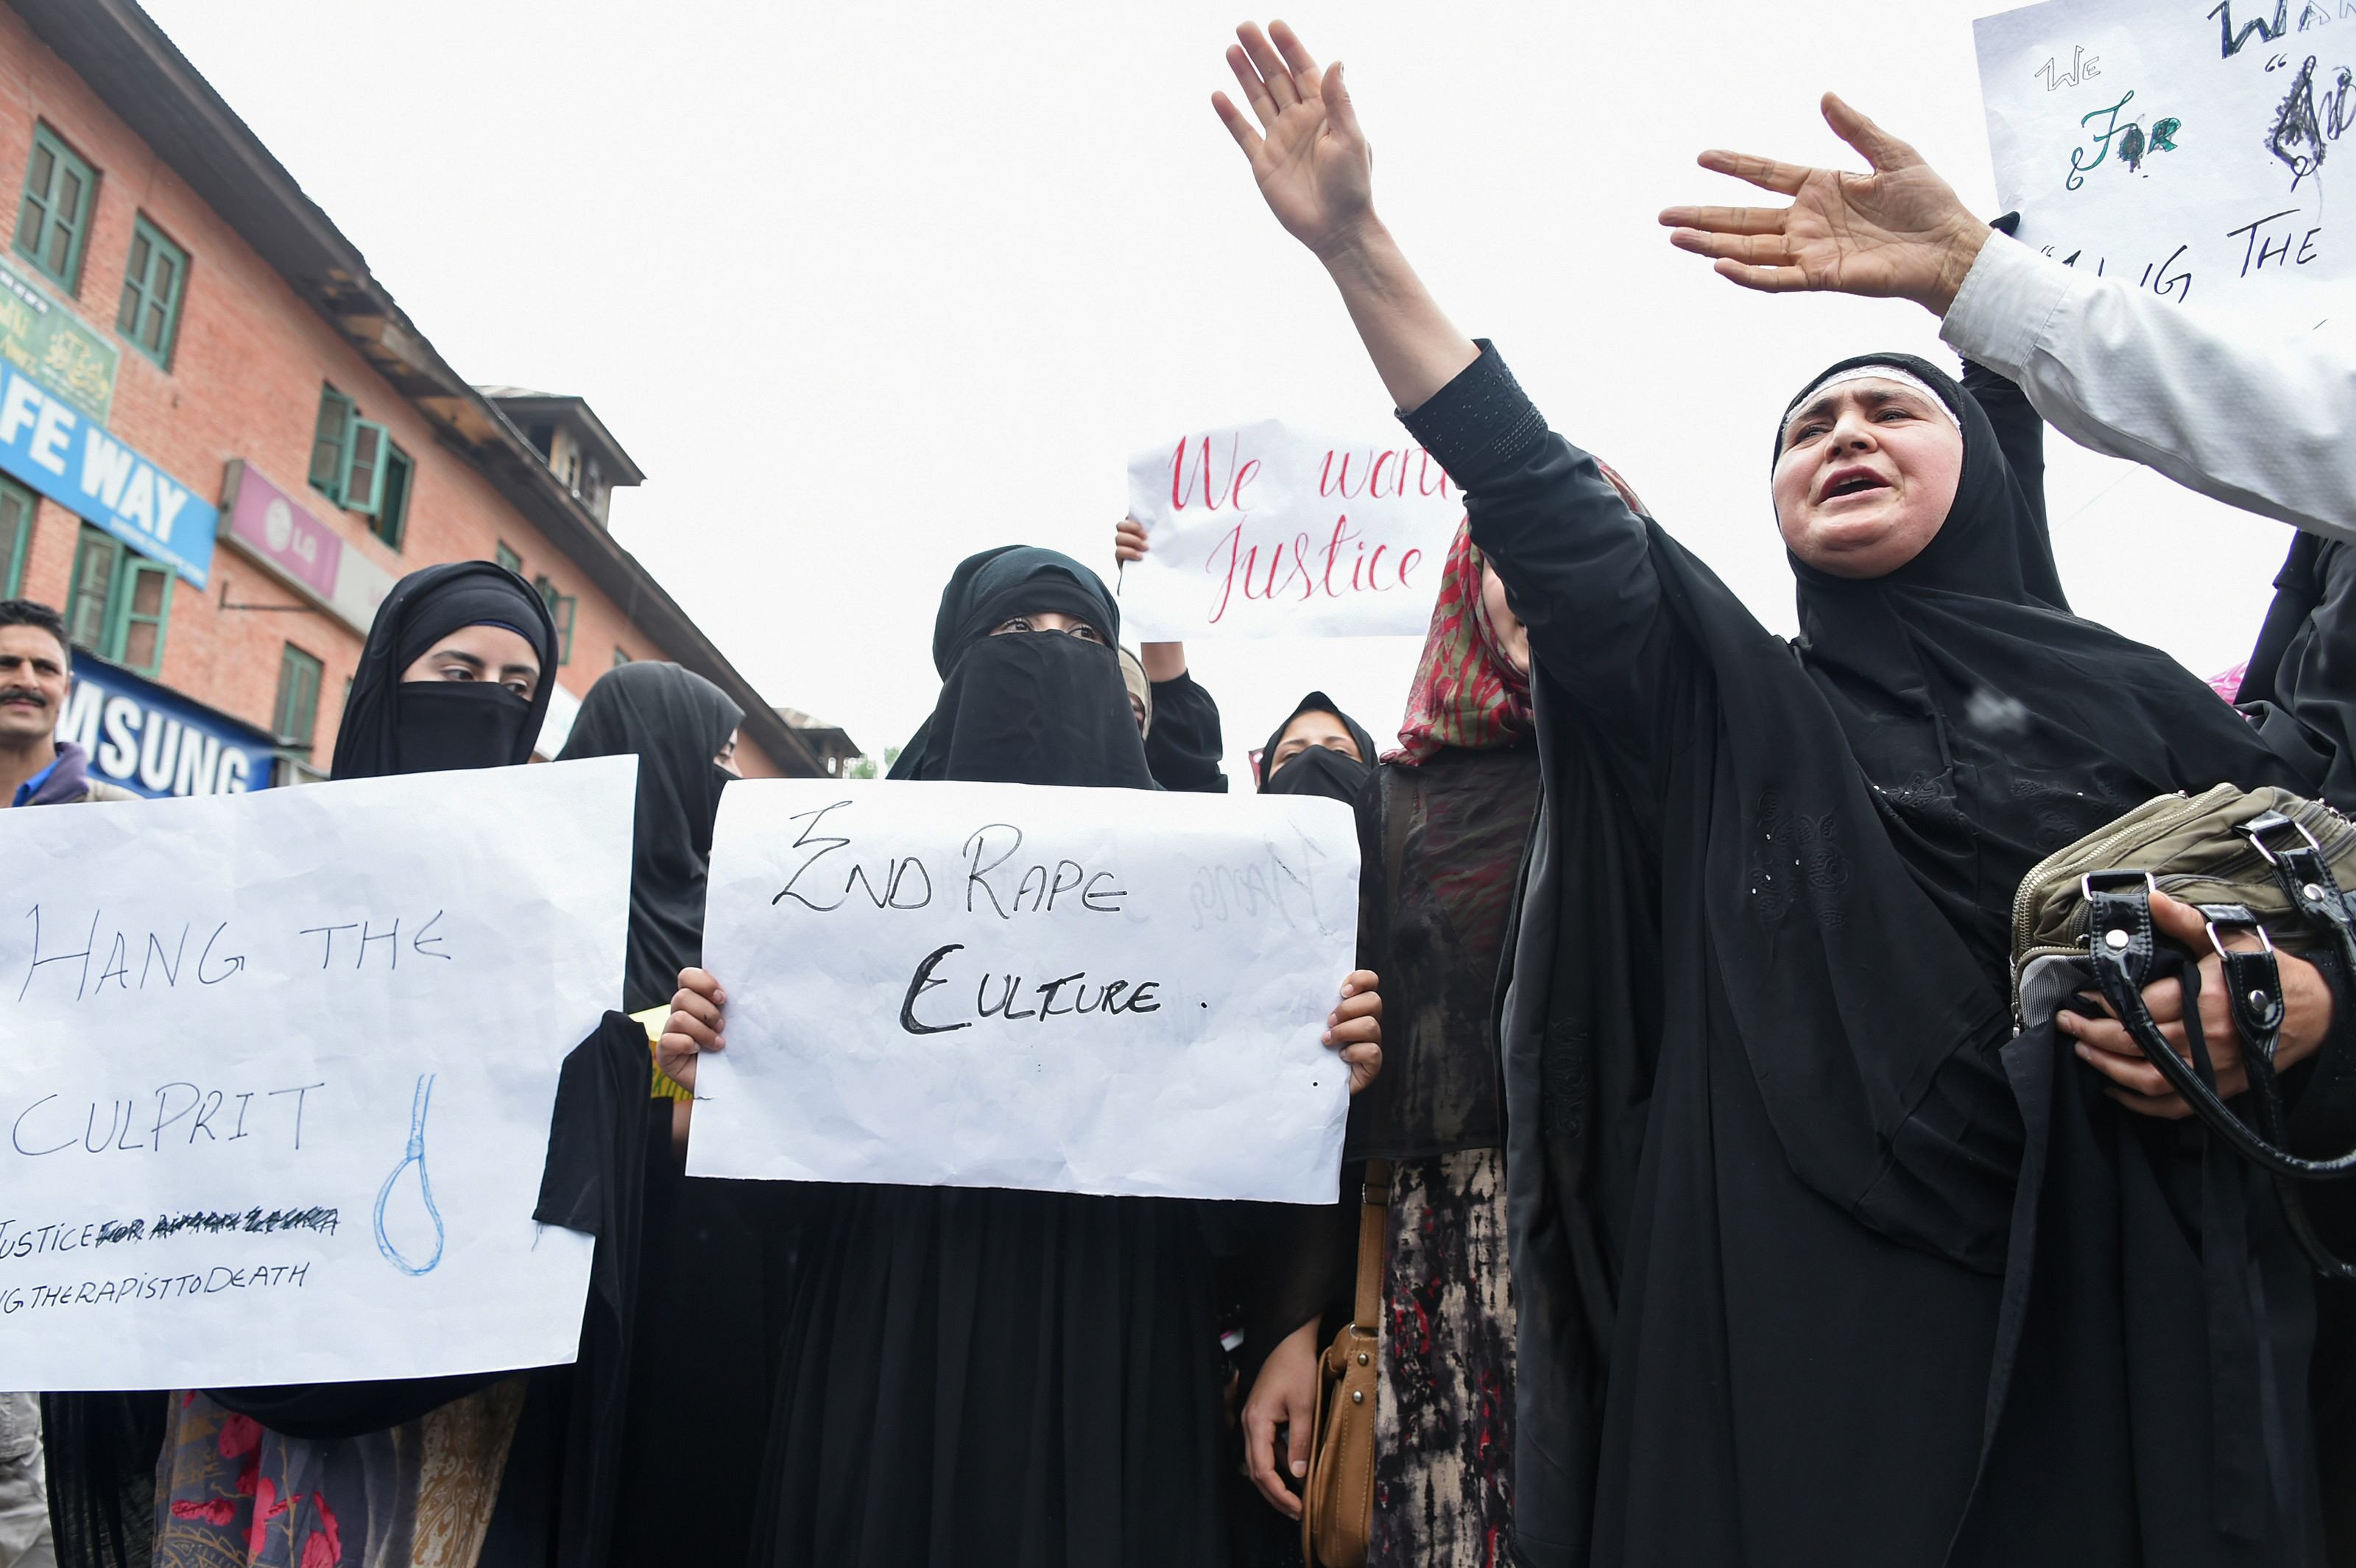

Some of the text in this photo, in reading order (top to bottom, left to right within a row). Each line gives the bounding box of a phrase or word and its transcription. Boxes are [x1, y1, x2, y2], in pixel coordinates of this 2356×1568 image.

[2034, 45, 2101, 91] WE
[2226, 208, 2321, 278] THE
[0, 372, 77, 477] FE
[80, 425, 189, 544] WAY
[1168, 431, 1261, 512] We
[292, 526, 317, 565] LG
[1205, 514, 1422, 624] Justice
[962, 822, 1129, 920] RAPE
[18, 903, 451, 1003] HANG THE
[13, 1082, 325, 1156] CULPRIT
